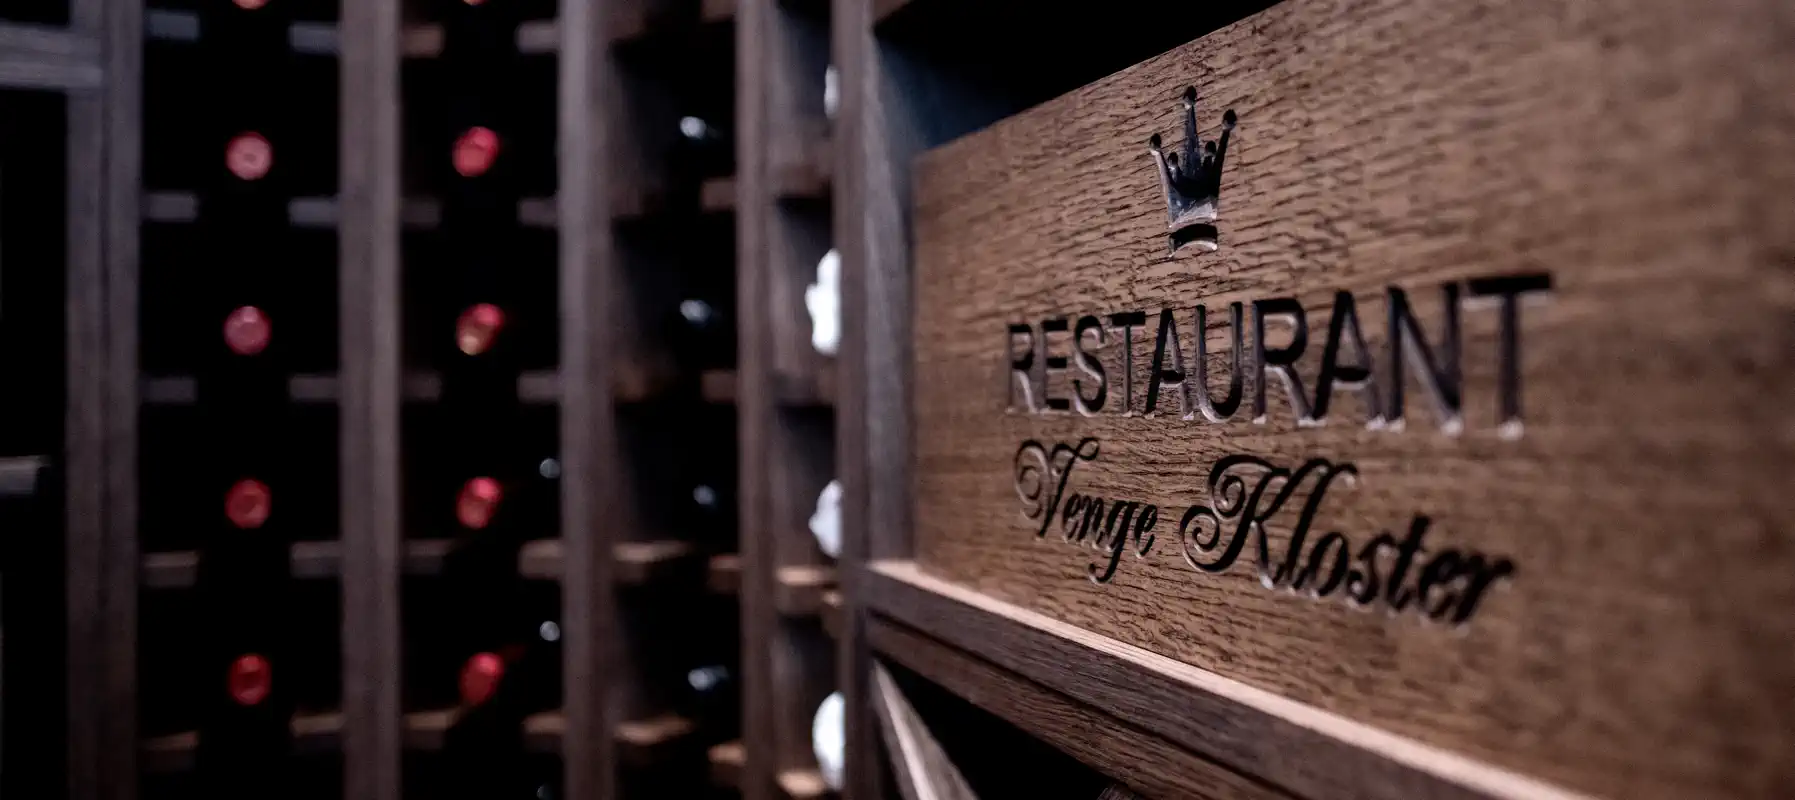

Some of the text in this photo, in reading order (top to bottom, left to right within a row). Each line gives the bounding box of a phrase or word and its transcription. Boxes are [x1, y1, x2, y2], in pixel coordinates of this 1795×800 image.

[1007, 272, 1551, 440] RESTAURANT
[1014, 437, 1515, 625] Venge Kloster
